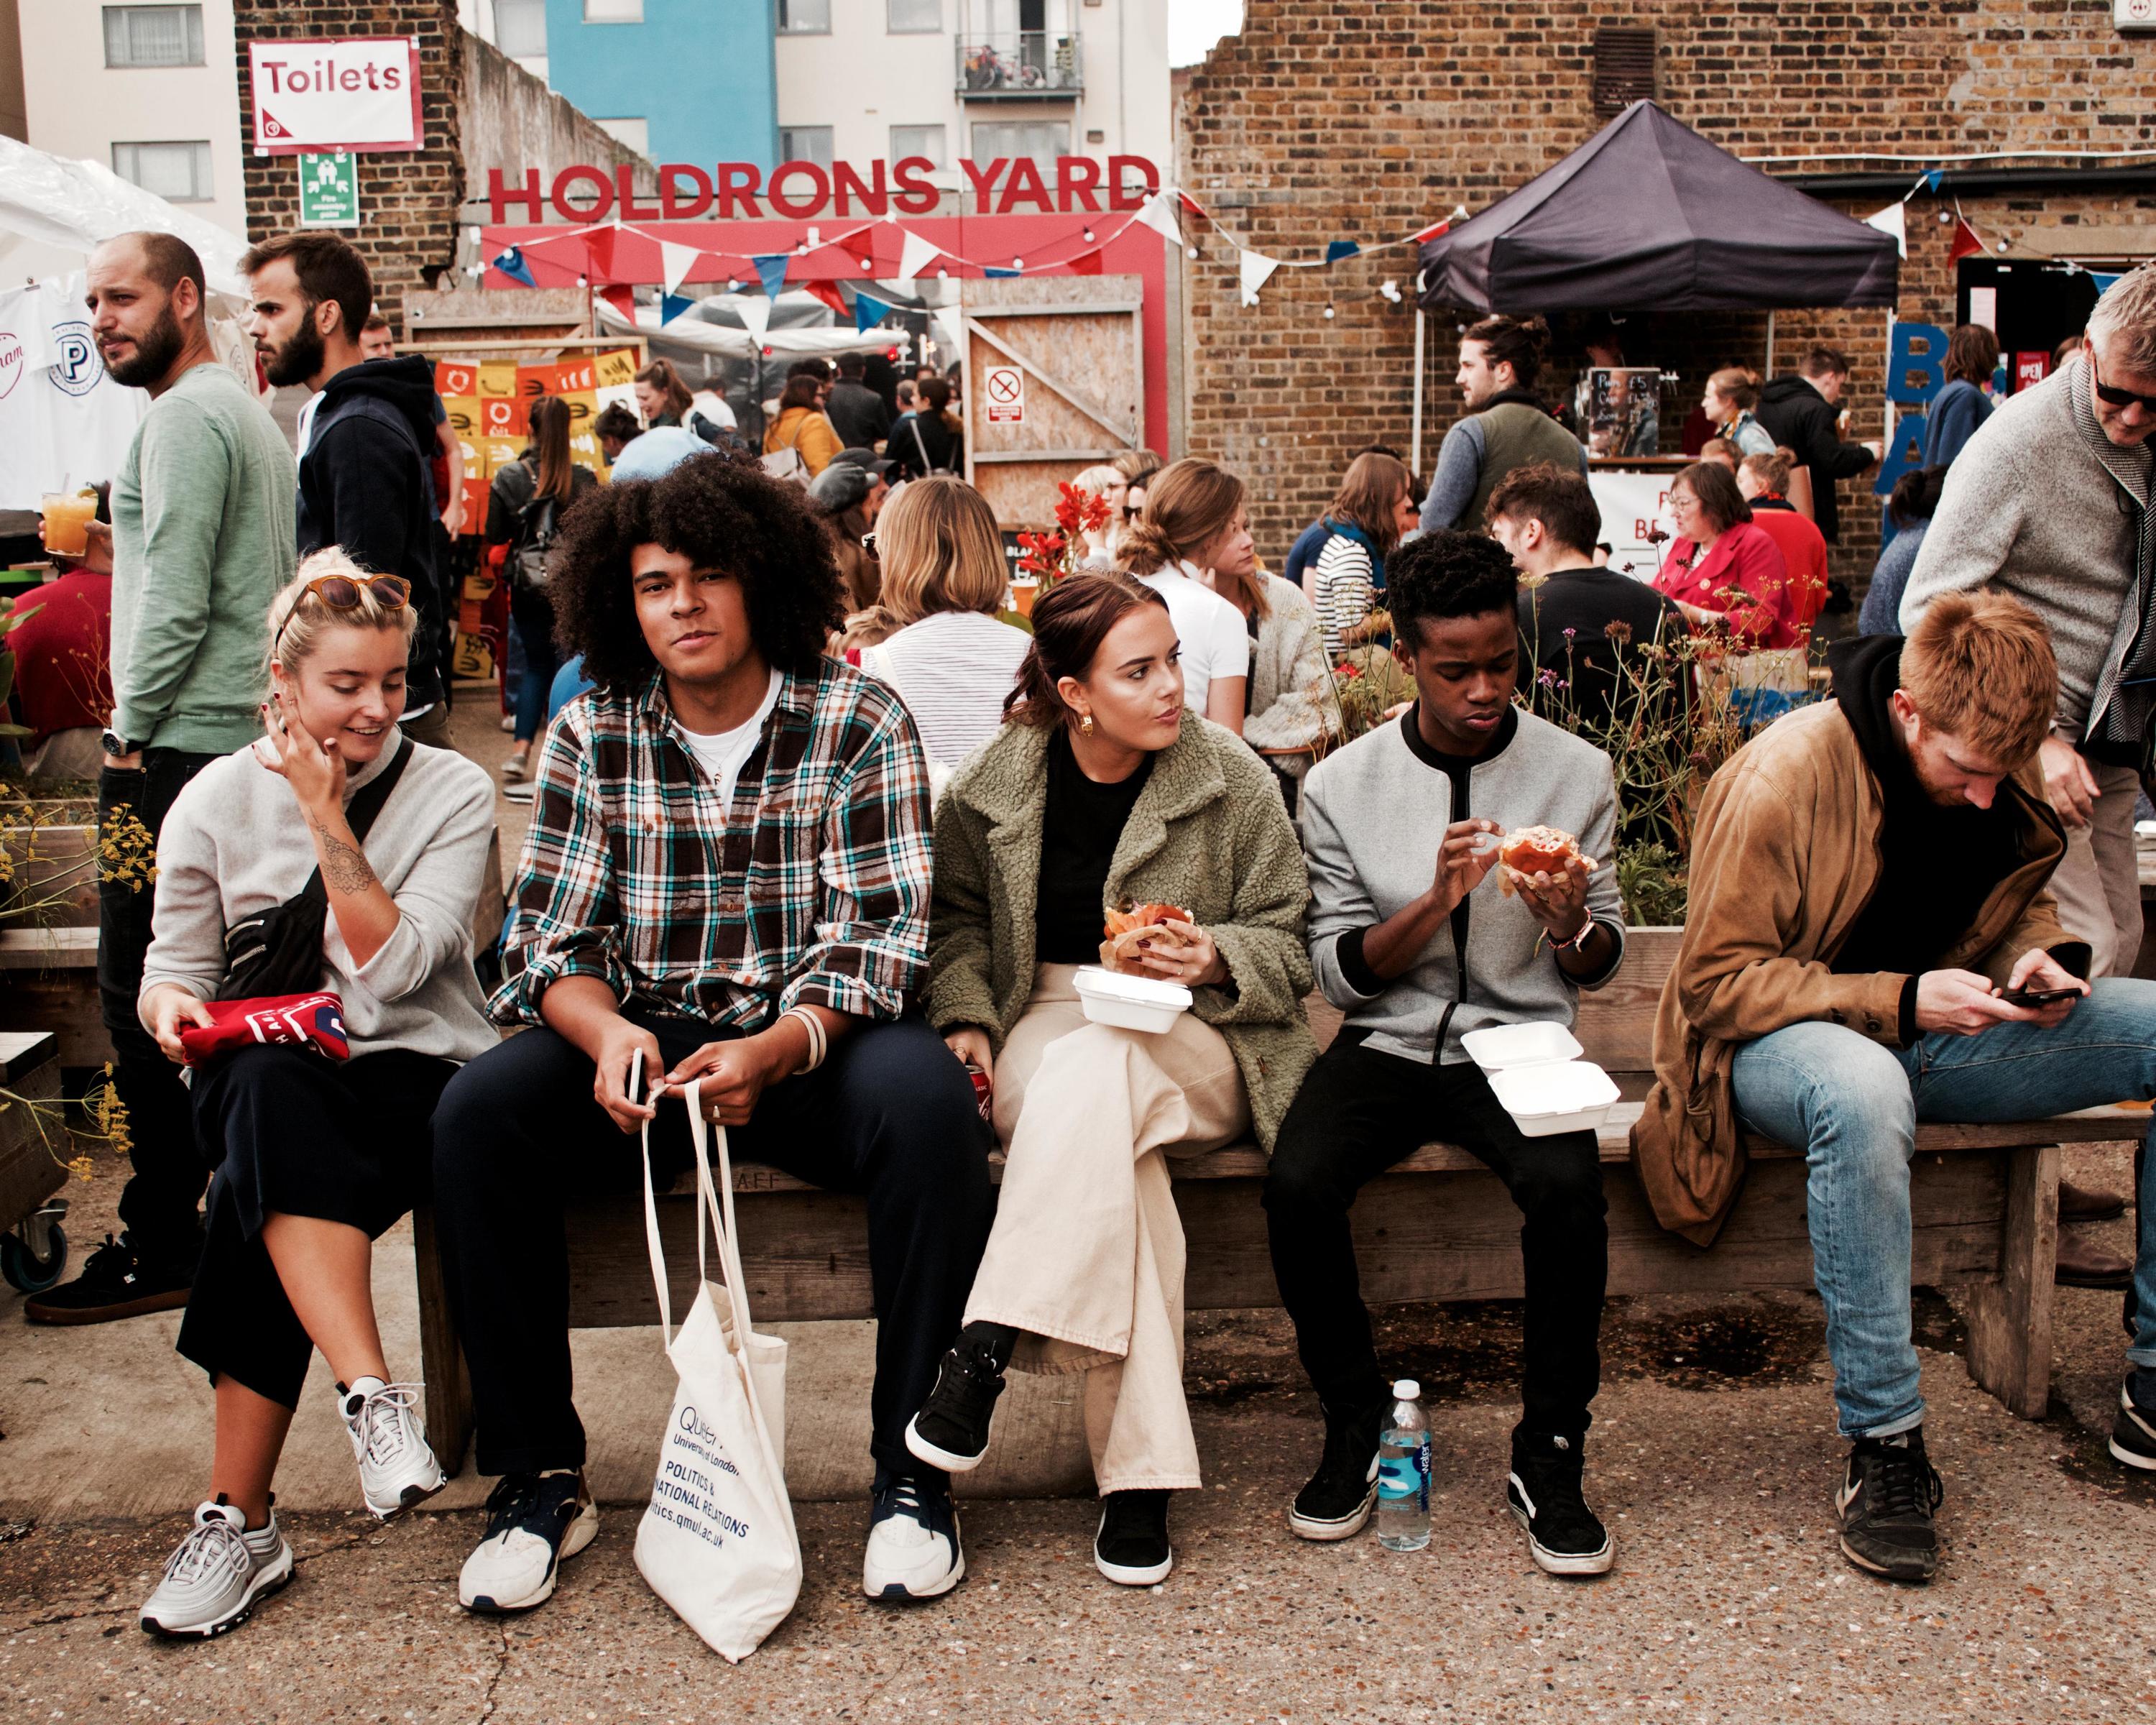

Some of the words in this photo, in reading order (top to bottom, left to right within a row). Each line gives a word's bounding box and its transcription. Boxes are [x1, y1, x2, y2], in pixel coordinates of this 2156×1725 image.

[262, 60, 401, 93] Toilets
[489, 156, 940, 224] HOLDRONS
[958, 155, 1159, 213] YARD
[665, 1460, 708, 1492] POLITICS
[709, 1482, 714, 1496] &
[702, 1500, 750, 1538] RELATIONS
